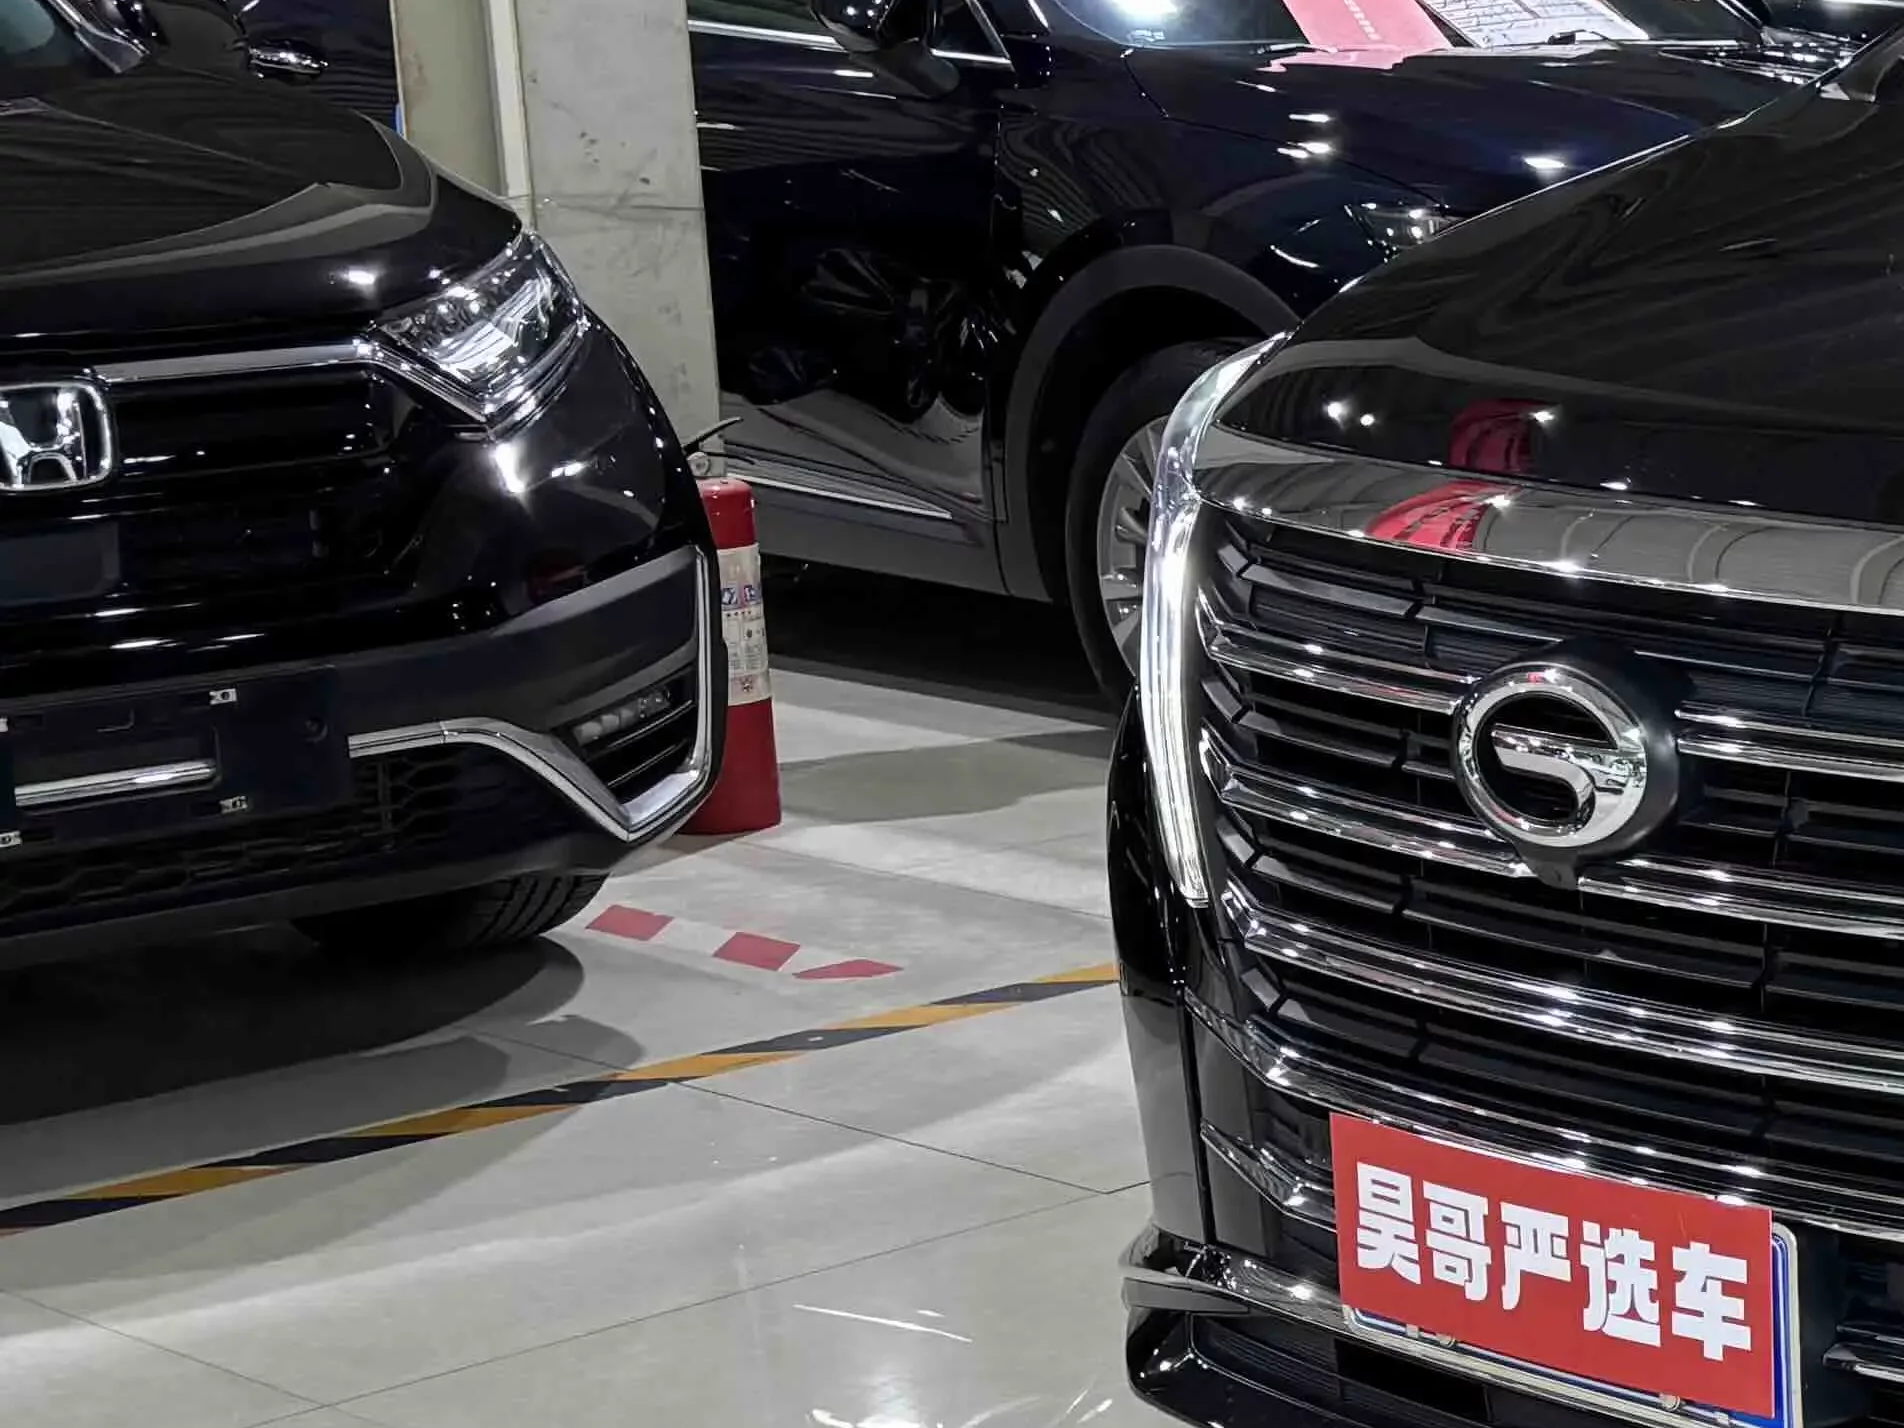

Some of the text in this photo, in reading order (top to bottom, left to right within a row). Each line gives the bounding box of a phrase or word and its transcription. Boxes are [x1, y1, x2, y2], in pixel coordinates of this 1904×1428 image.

[1355, 1160, 1753, 1363] 昊哥严选车
